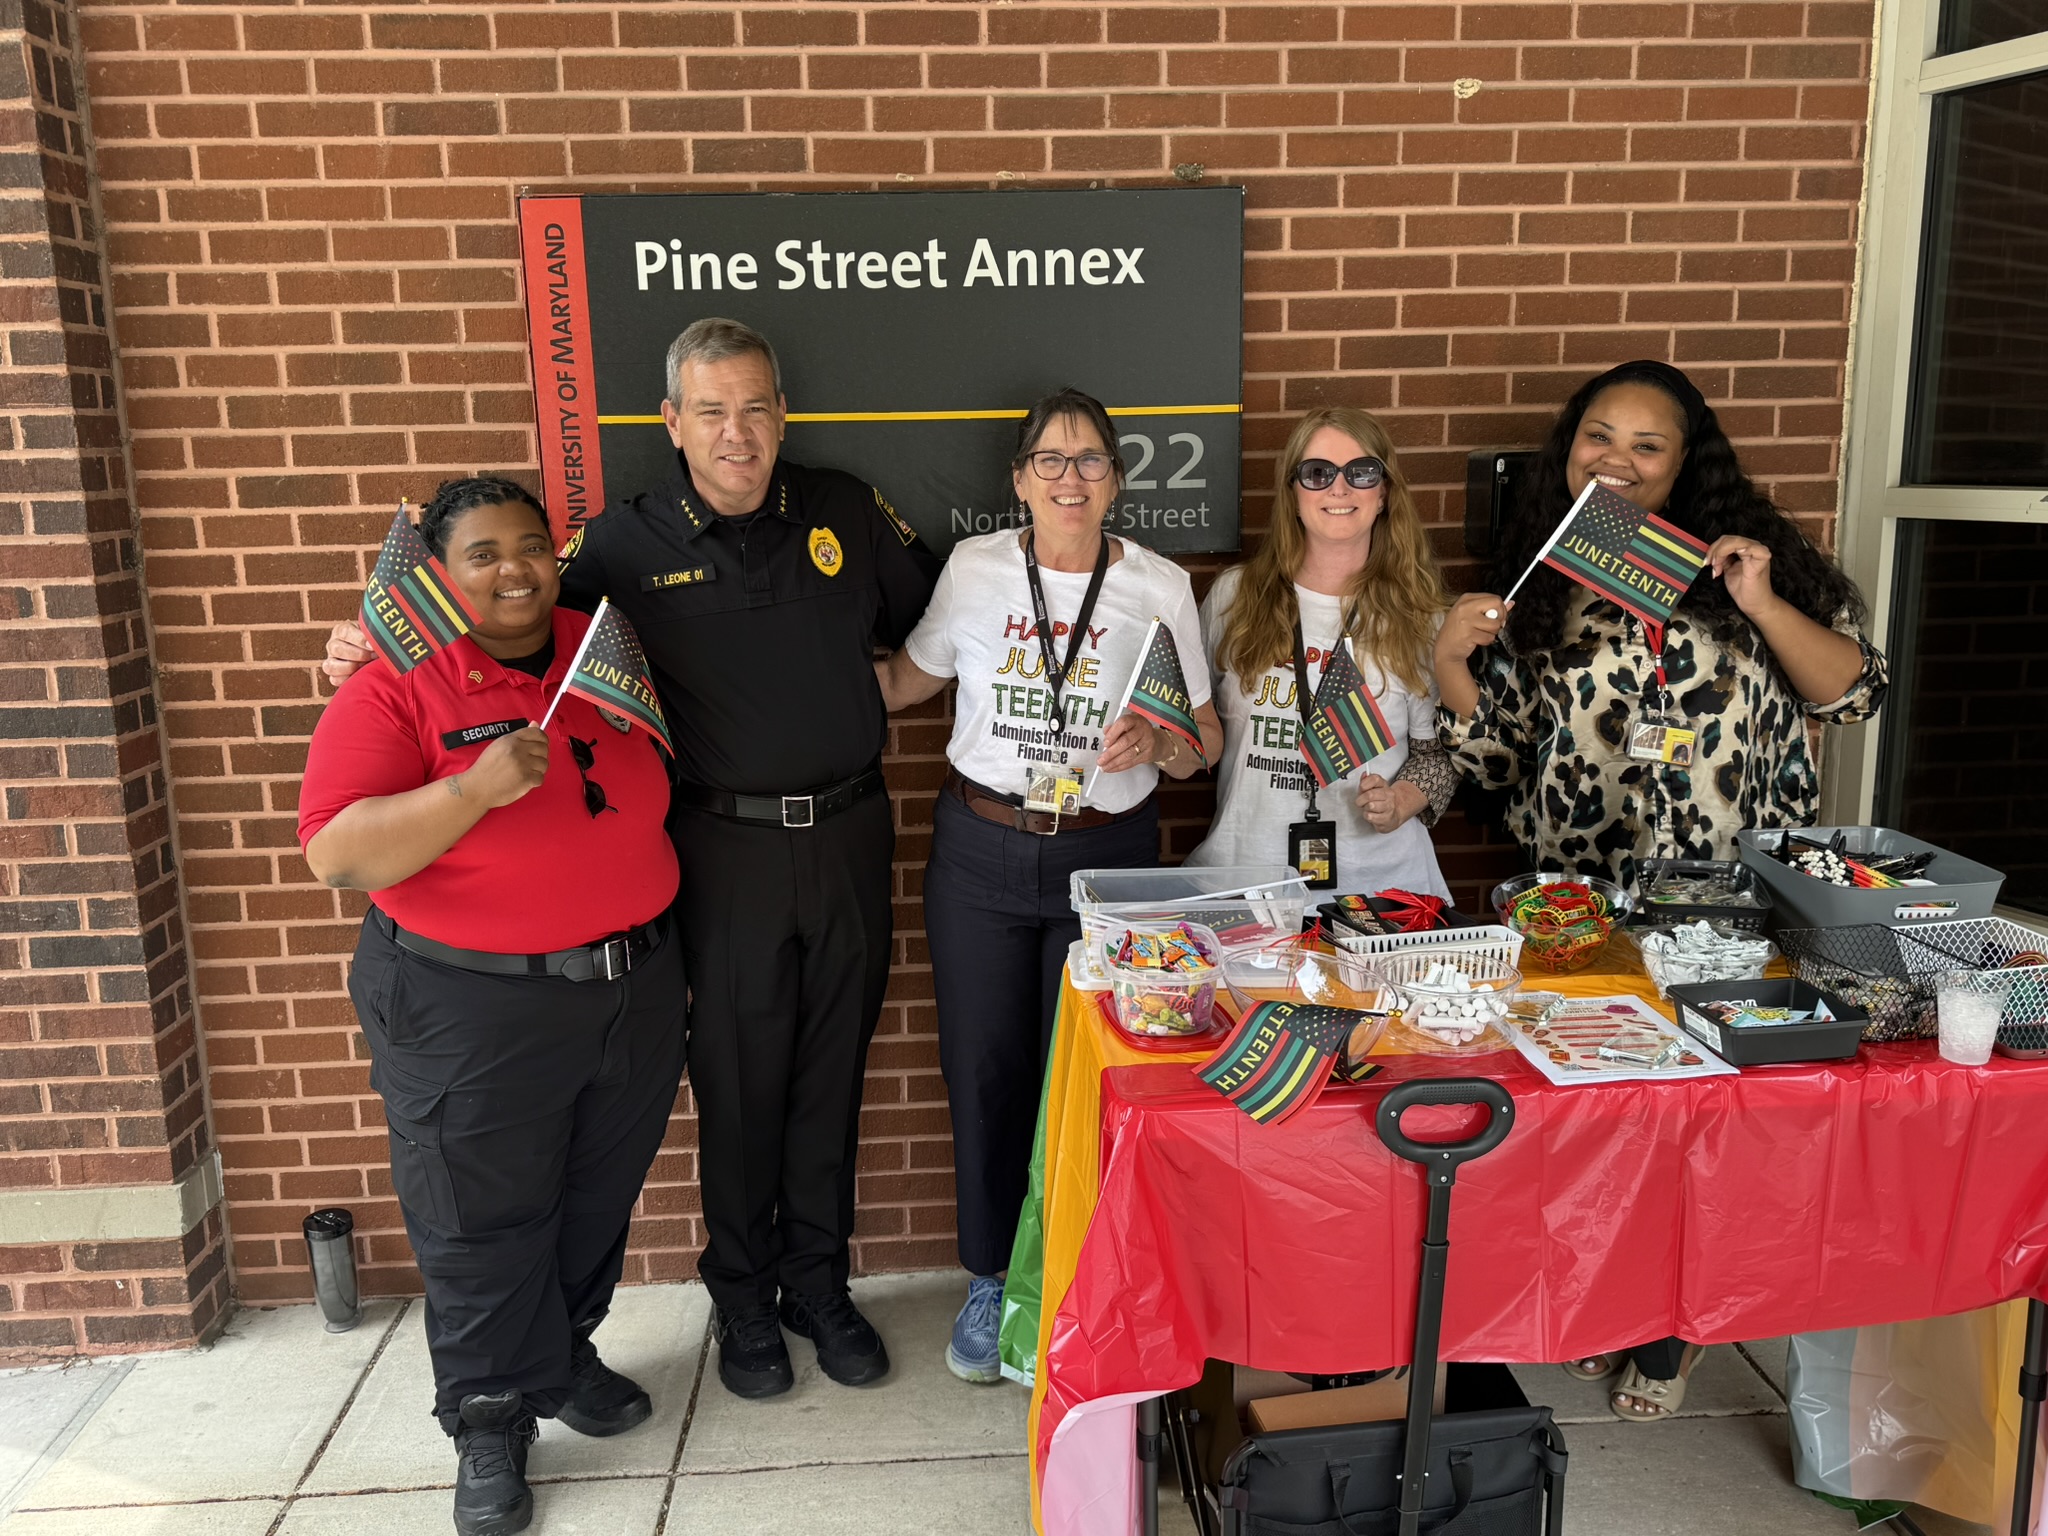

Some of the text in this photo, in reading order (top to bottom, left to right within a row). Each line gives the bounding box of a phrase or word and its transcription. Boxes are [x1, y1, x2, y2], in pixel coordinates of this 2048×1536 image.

[634, 237, 1145, 291] Pine Street Annex
[544, 223, 575, 365] MARYLAND
[557, 371, 580, 402] OF
[951, 507, 1032, 533] Nort
[1121, 501, 1210, 530] Street
[652, 568, 704, 588] T. LEONE 01
[1565, 534, 1679, 608] JUNETEENTH
[462, 722, 511, 742] SECURITY
[1090, 736, 1100, 751] &
[1309, 704, 1351, 774] TEENTH
